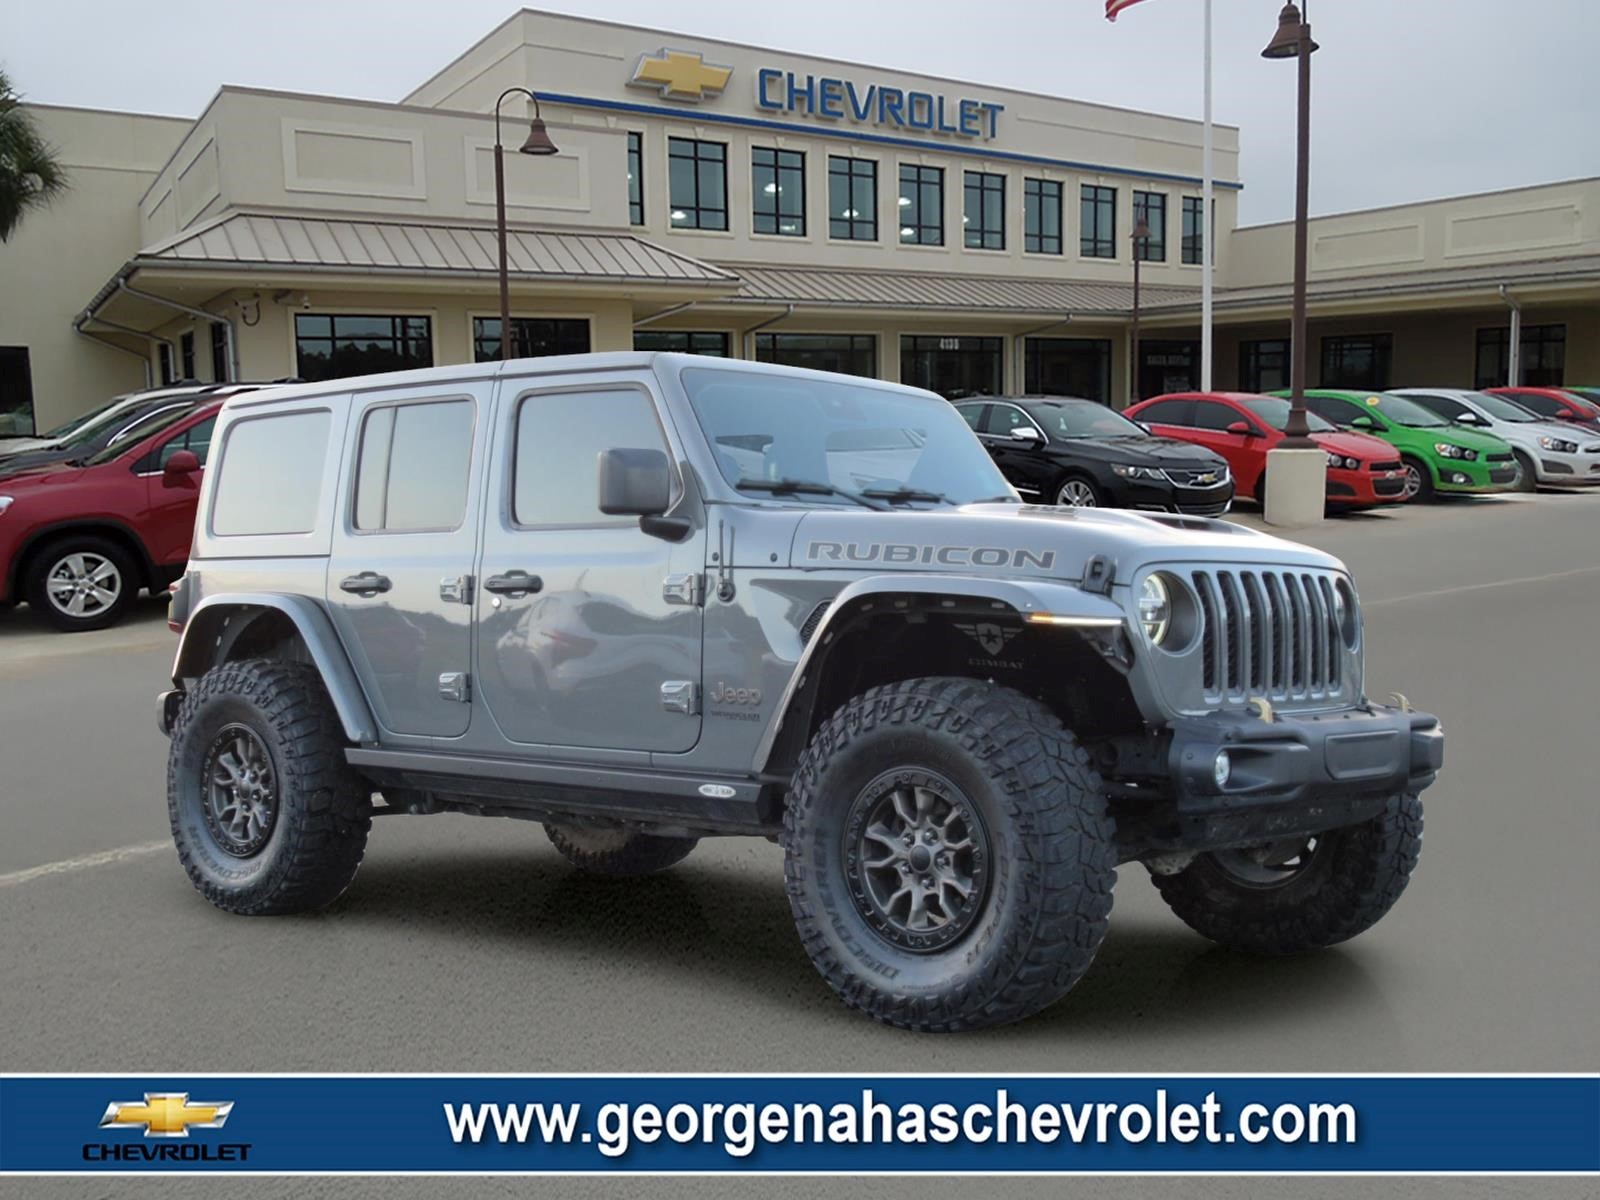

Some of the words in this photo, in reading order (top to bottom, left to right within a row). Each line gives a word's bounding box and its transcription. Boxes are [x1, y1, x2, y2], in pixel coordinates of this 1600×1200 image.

[756, 68, 1004, 138] CHEVROLET
[807, 541, 1056, 570] RUBICON
[710, 680, 762, 705] Jeep
